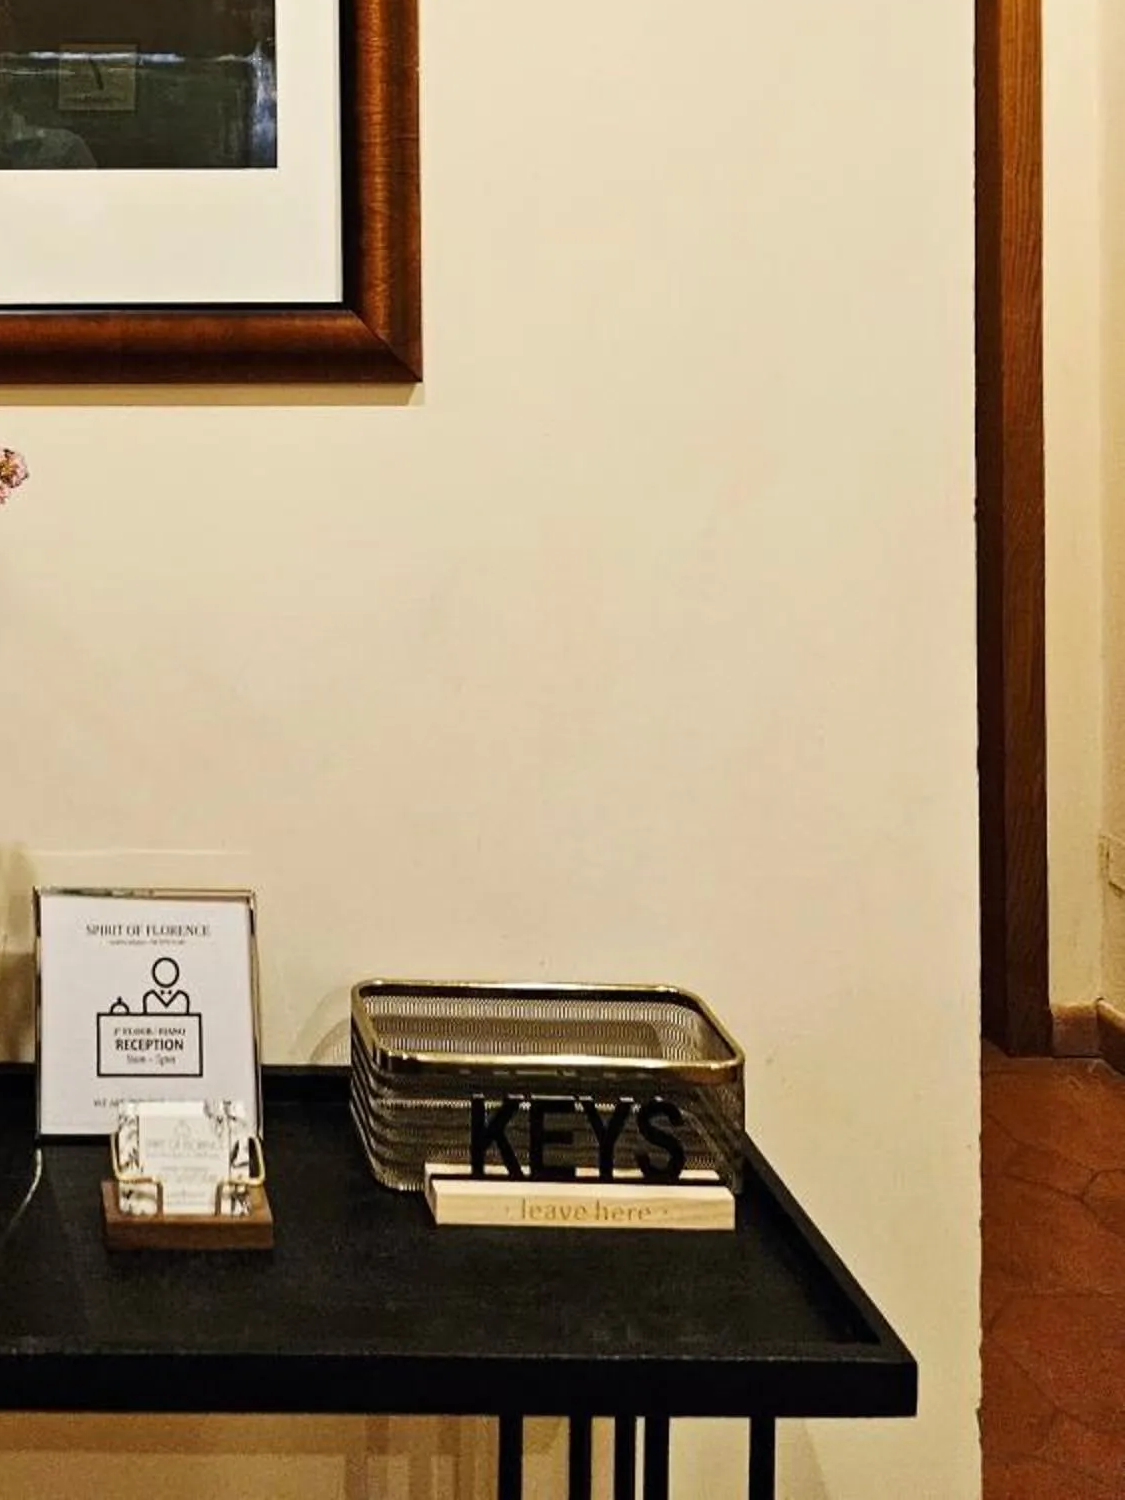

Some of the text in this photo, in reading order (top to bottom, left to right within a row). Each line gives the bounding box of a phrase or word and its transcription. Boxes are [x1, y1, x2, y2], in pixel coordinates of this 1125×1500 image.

[86, 923, 211, 938] SPIRIT OF FLORENCE
[115, 1039, 184, 1051] RECEPTION
[470, 1093, 686, 1181] KEYS
[522, 1198, 652, 1221] leave here
